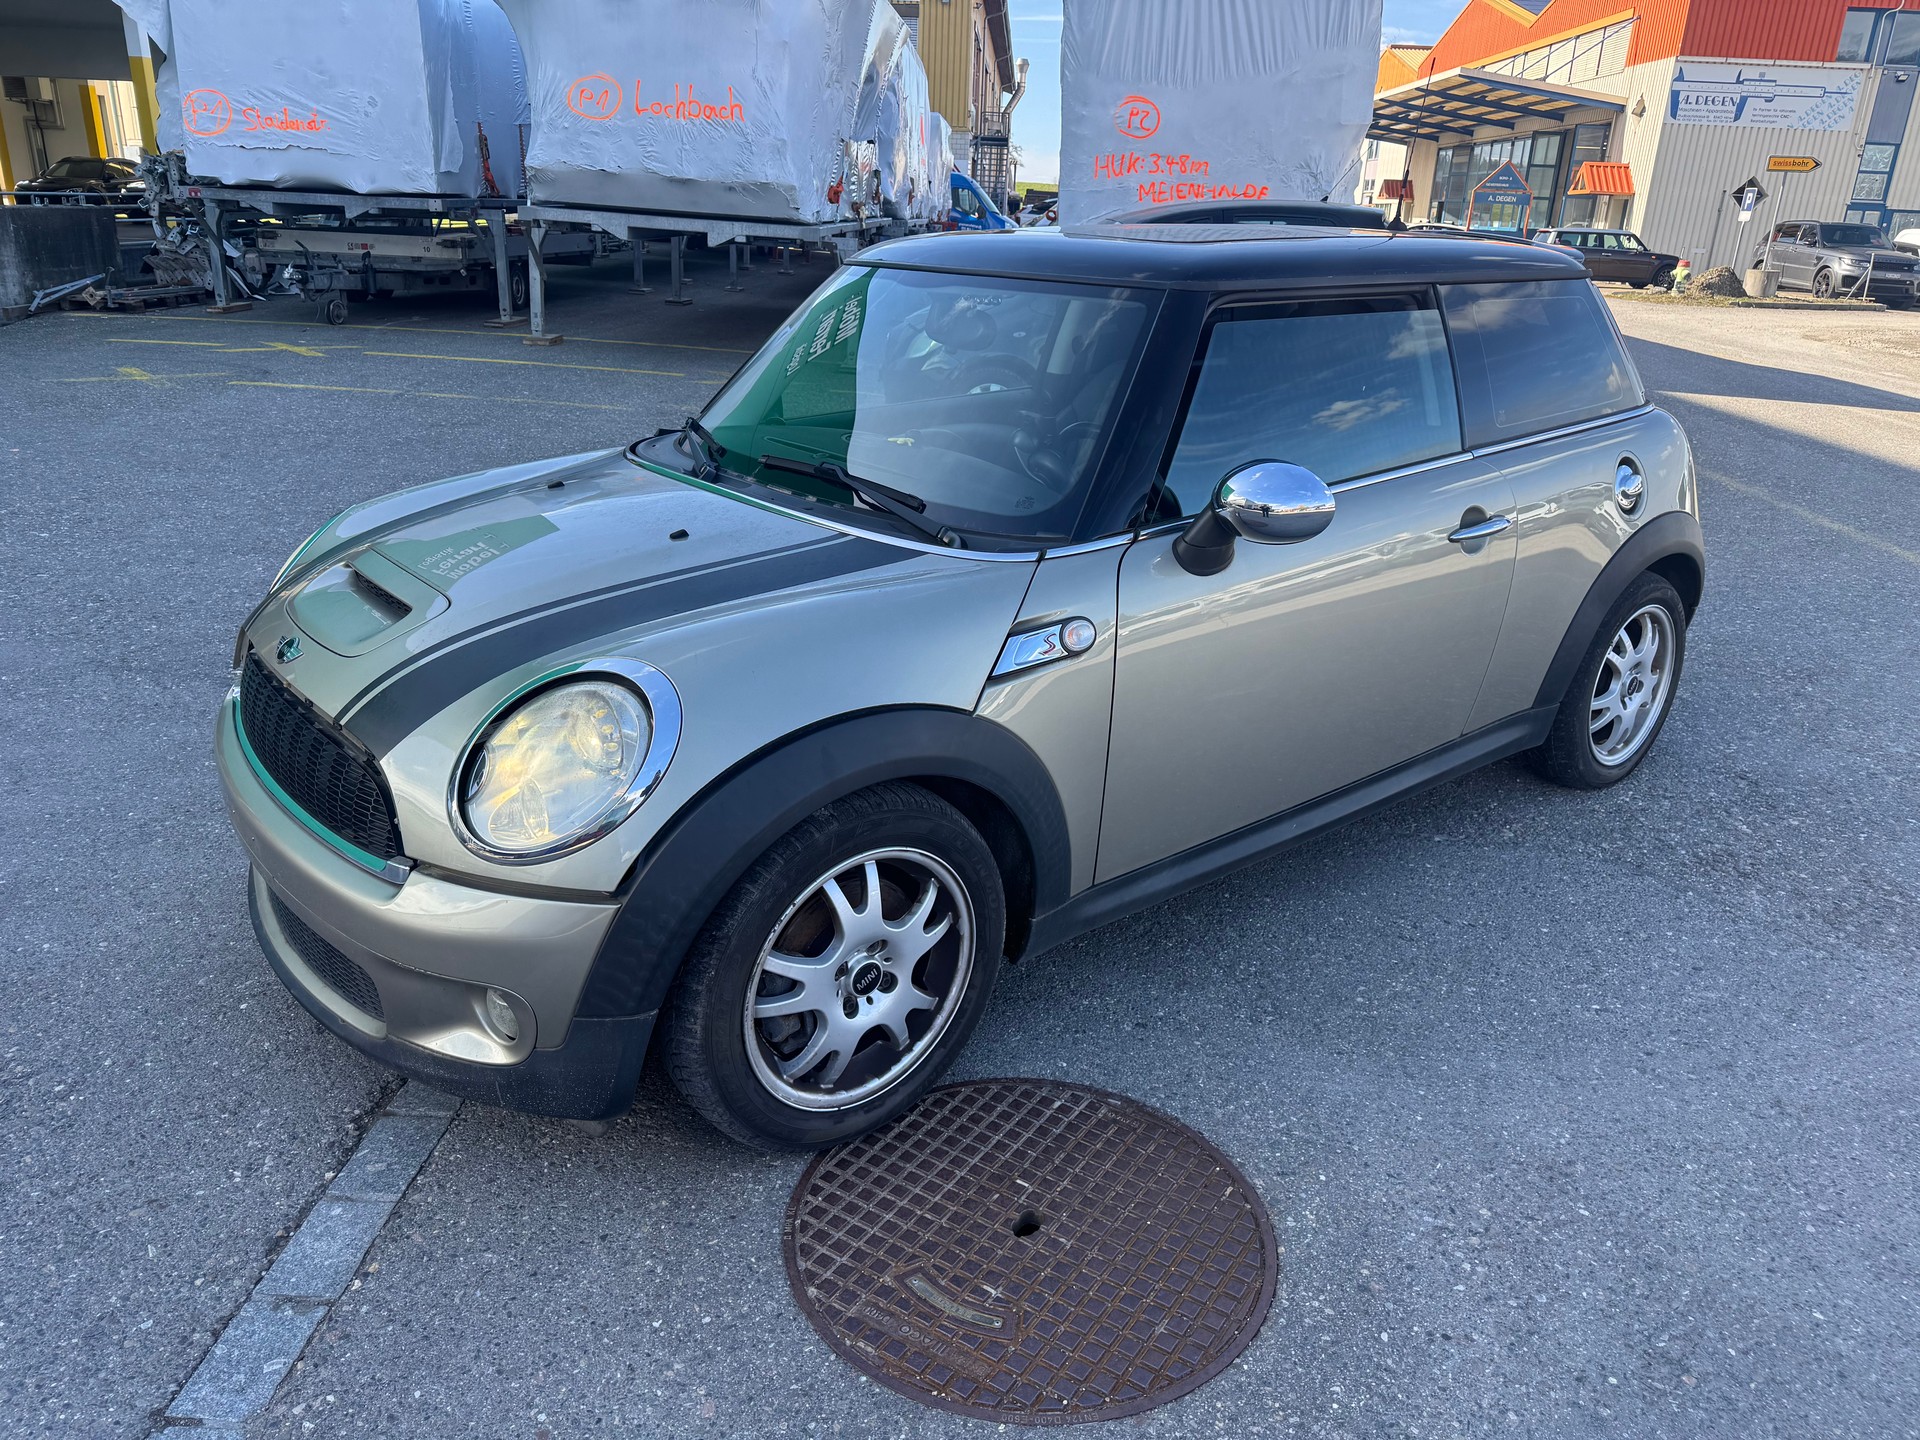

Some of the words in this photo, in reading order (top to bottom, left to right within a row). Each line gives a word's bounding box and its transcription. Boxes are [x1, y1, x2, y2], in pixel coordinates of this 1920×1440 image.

[579, 87, 609, 112] P1
[635, 79, 745, 122] Lochbach
[1680, 95, 1692, 105] A.
[1695, 95, 1738, 107] DEGEN
[190, 99, 223, 129] P1
[1127, 106, 1151, 132] P2
[1148, 153, 1209, 178] 3.48m
[1773, 159, 1809, 167] swissbohr
[1744, 192, 1753, 210] P
[1043, 633, 1057, 656] S
[856, 968, 878, 991] MINI
